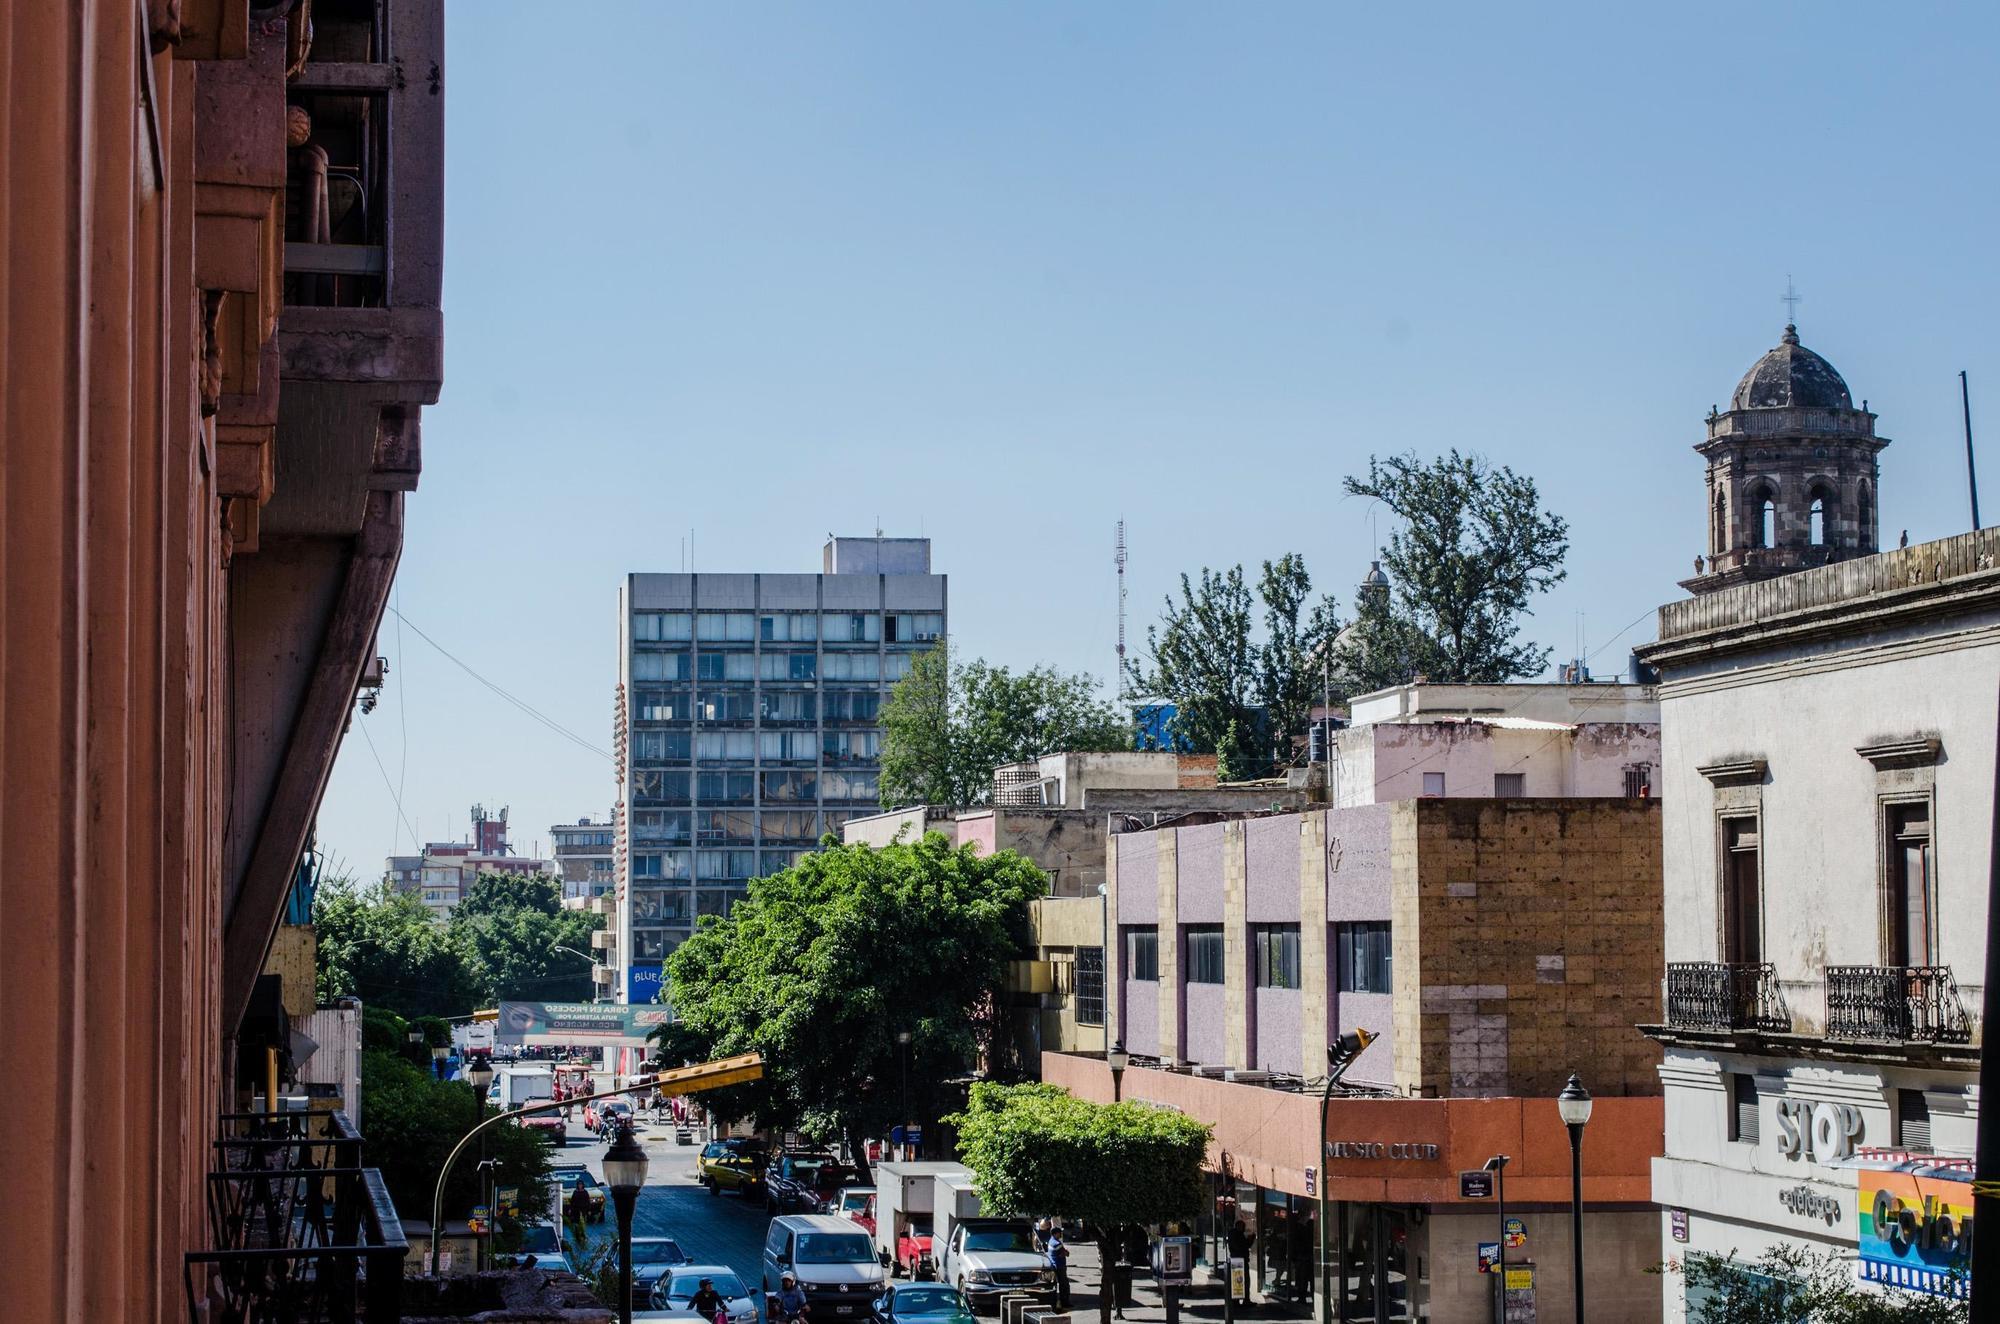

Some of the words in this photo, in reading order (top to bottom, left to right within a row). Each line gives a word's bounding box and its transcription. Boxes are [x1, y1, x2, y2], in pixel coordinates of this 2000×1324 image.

[634, 970, 658, 983] BLUE
[1776, 1099, 1862, 1162] STOP
[1325, 1141, 1384, 1159] MUSIC
[1388, 1142, 1439, 1160] CLUB
